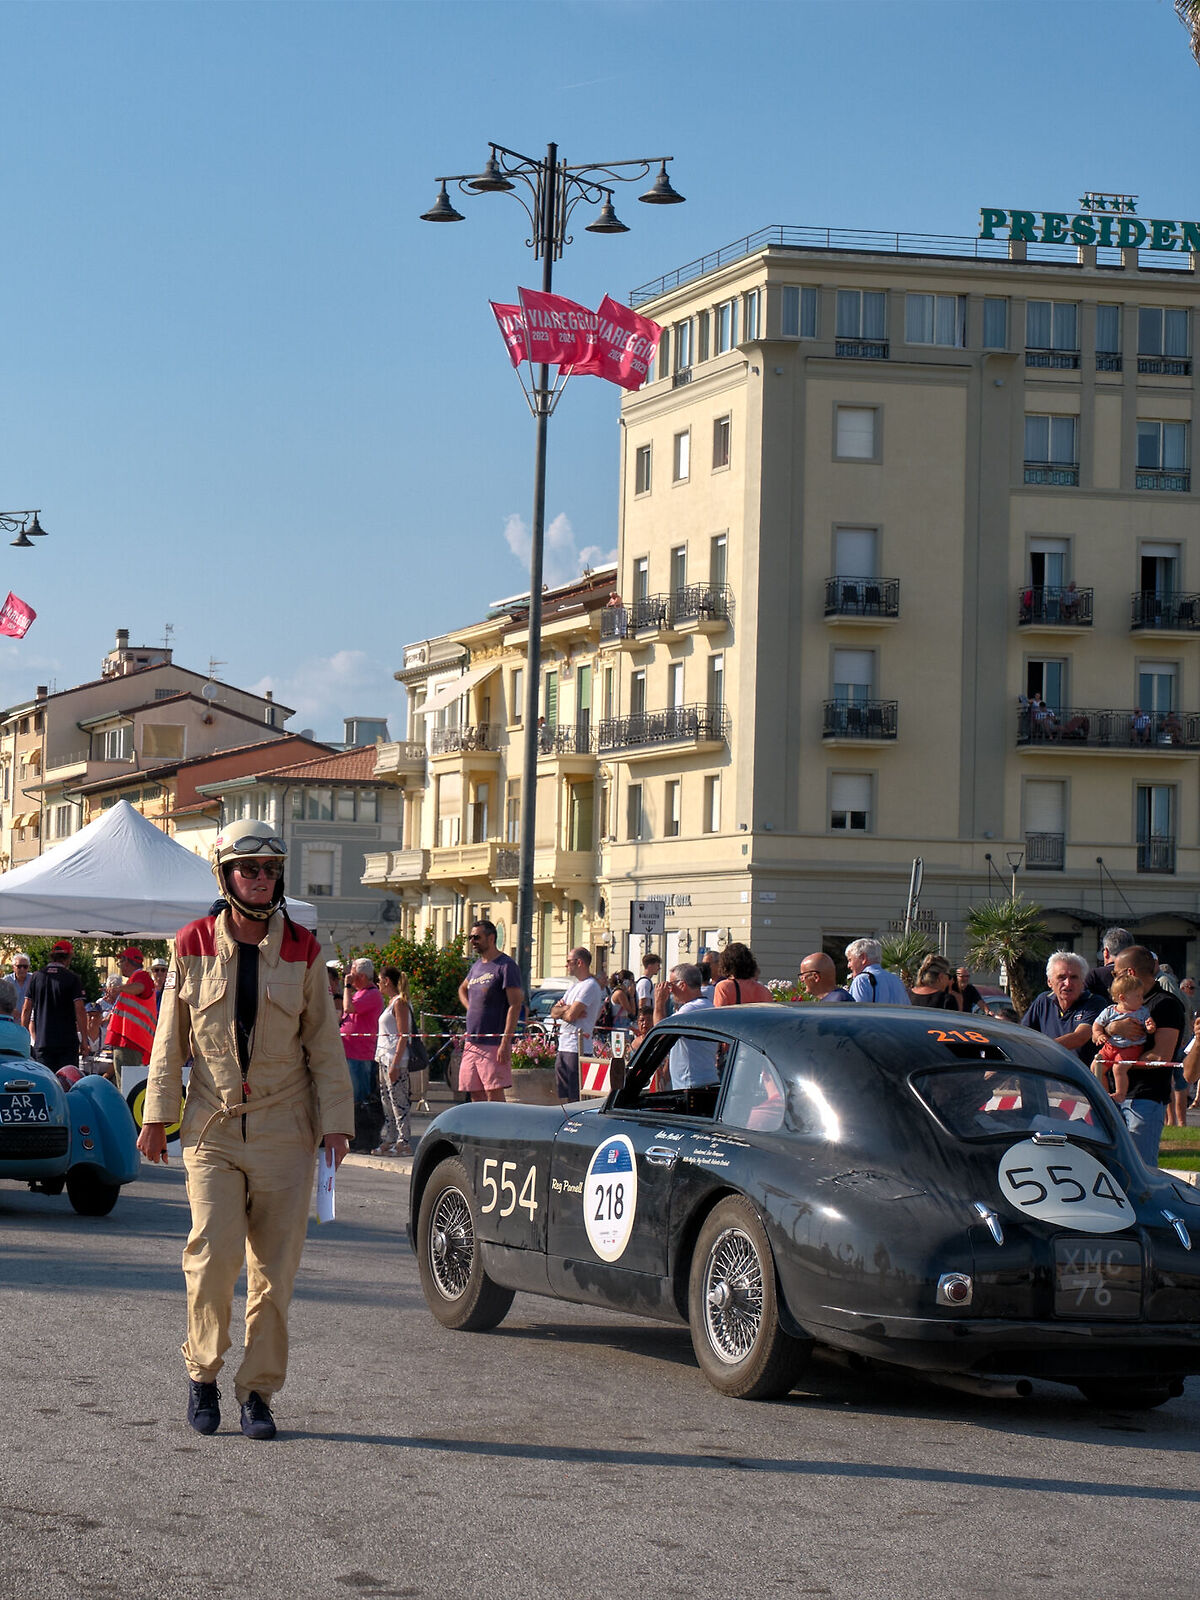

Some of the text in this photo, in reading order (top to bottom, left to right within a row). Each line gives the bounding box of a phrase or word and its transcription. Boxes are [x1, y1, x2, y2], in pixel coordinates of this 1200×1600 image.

[527, 308, 598, 331] VIAREGGIO
[532, 331, 549, 341] 2023
[559, 332, 576, 343] 2024
[598, 317, 657, 361] IAREGGIO
[902, 909, 935, 921] HTEL
[927, 1029, 990, 1043] 218
[11, 1095, 33, 1107] AR
[481, 1158, 538, 1222] 554
[1005, 1165, 1125, 1209] 554
[594, 1182, 625, 1221] 218
[1062, 1248, 1124, 1275] XMC
[1071, 1276, 1112, 1306] 76
